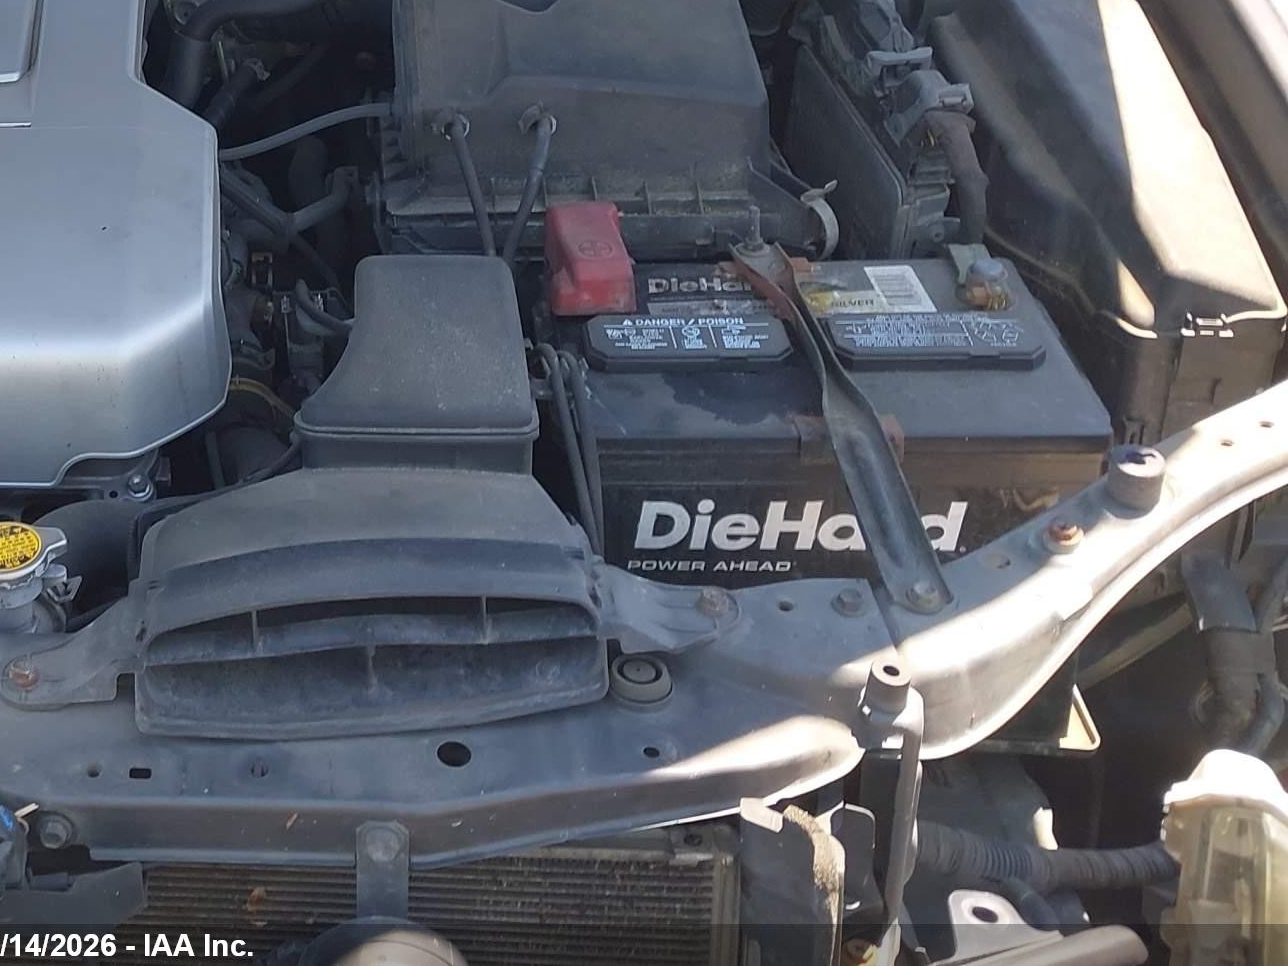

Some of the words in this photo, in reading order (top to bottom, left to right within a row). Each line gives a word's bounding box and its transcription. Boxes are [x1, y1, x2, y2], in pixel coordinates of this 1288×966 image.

[635, 318, 688, 327] DANGER
[697, 317, 745, 326] POISON
[634, 498, 968, 552] DieHad
[627, 560, 706, 572] POWER
[713, 560, 793, 572] AHEAD
